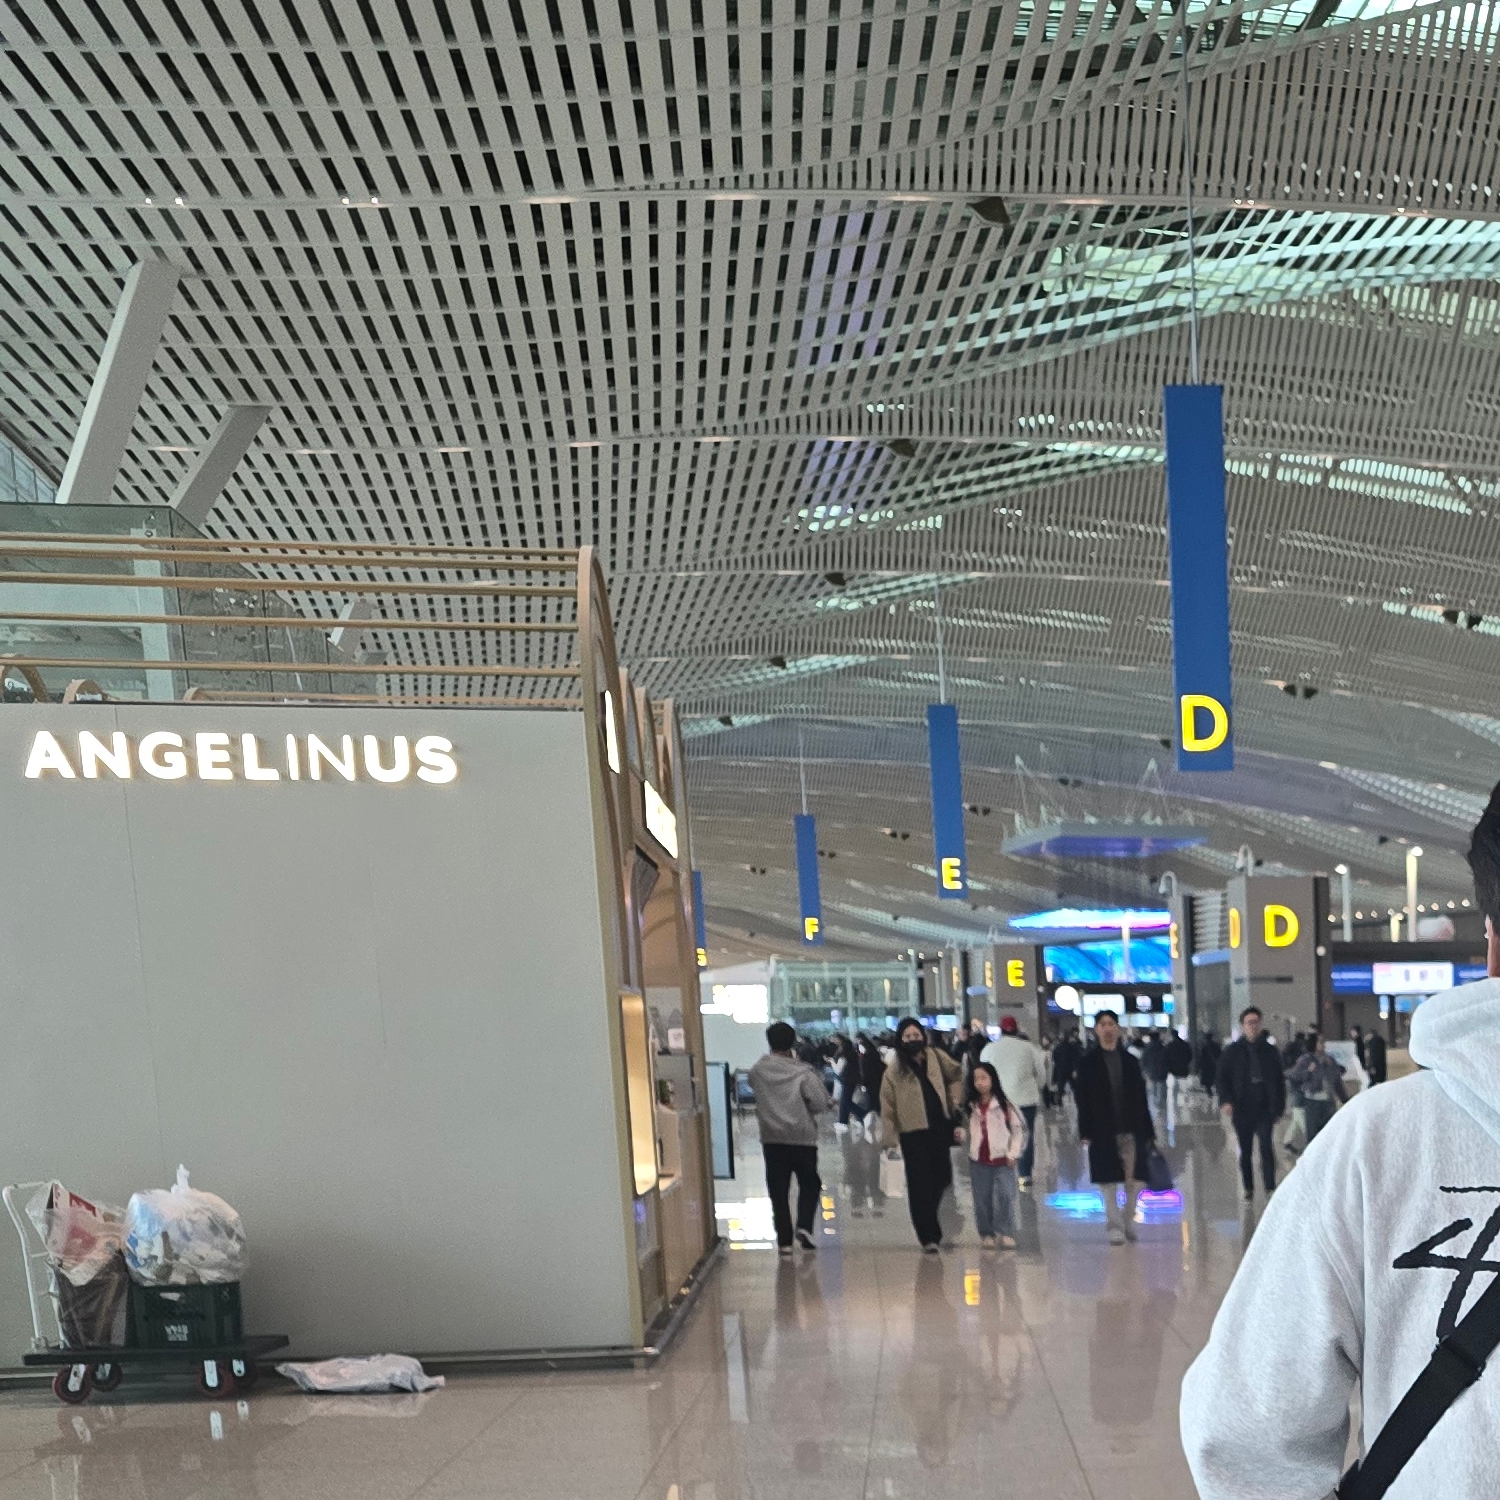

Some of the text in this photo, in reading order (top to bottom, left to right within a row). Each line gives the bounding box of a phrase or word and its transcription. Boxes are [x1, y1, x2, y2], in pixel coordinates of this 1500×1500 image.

[1180, 694, 1229, 752] D
[25, 730, 459, 785] ANGELINUS
[941, 857, 963, 890] E
[804, 917, 819, 941] F
[1263, 904, 1299, 947] D
[1006, 959, 1025, 987] E
